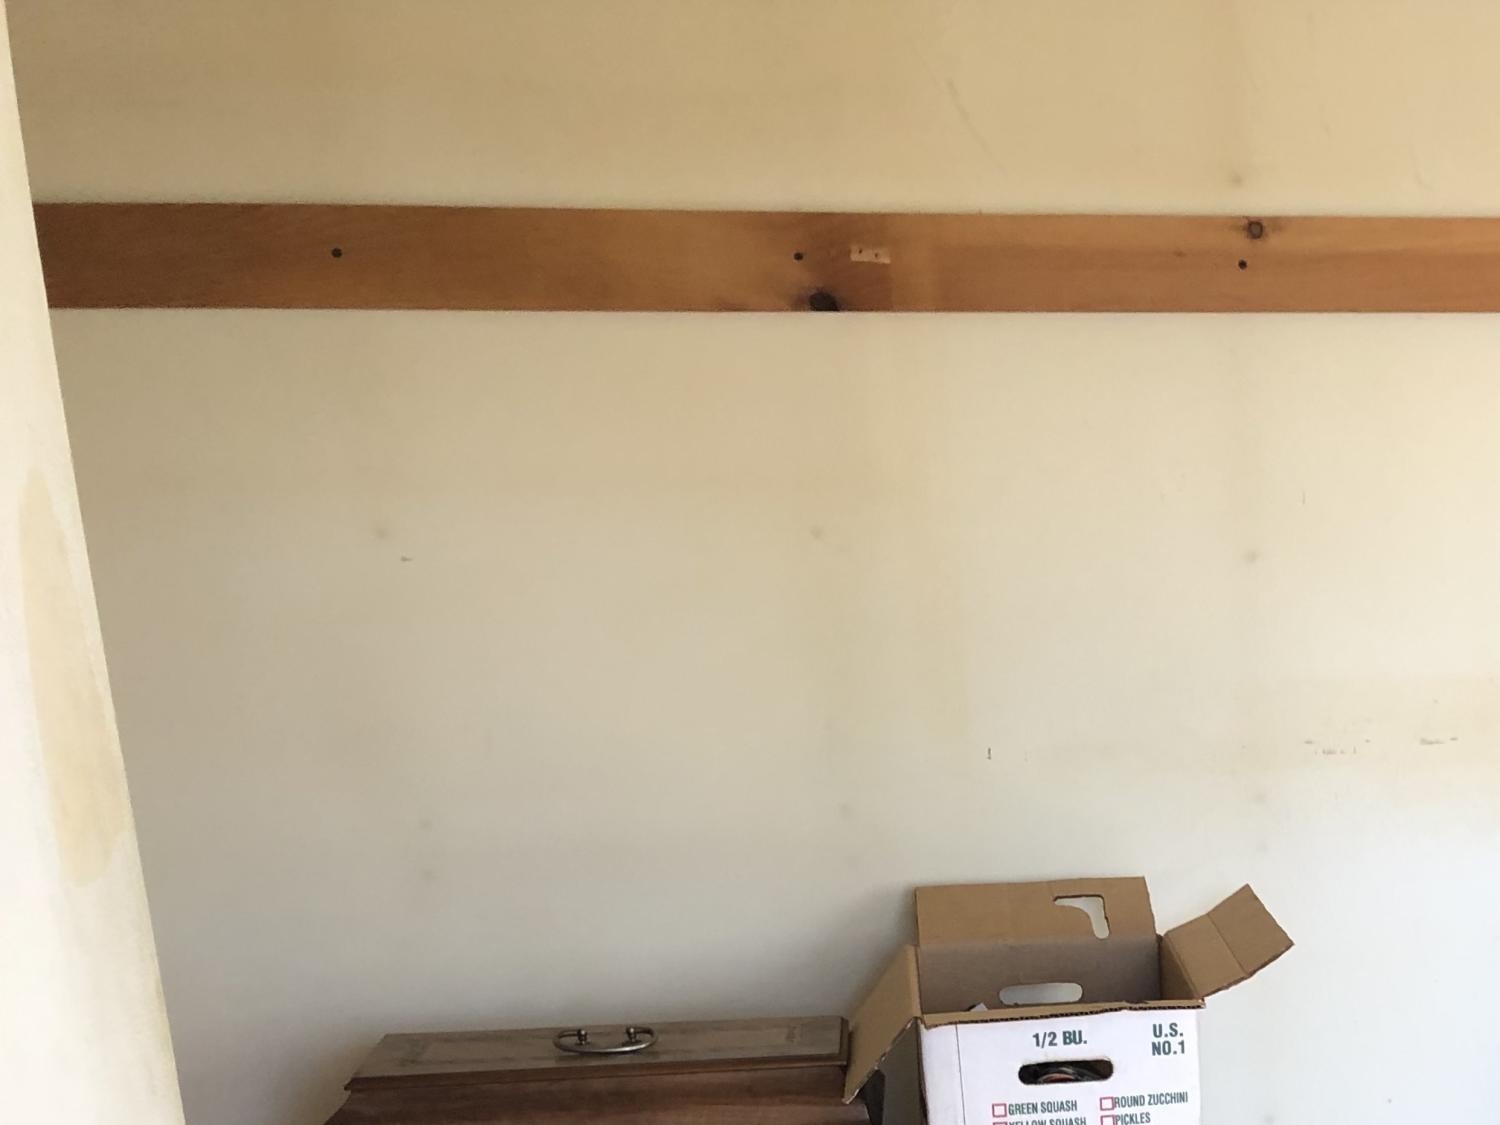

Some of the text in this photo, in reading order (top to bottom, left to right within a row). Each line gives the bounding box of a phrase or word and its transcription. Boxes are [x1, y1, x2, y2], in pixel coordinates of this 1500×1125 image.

[1152, 1022, 1184, 1038] U.S.
[1032, 1030, 1088, 1048] 1/2 BU.
[1151, 1040, 1186, 1056] NO.1
[1008, 1099, 1078, 1116] GREEN SQUASH
[1114, 1091, 1189, 1109] ROUND ZUCCHINI
[1115, 1111, 1151, 1125] PICKLES
